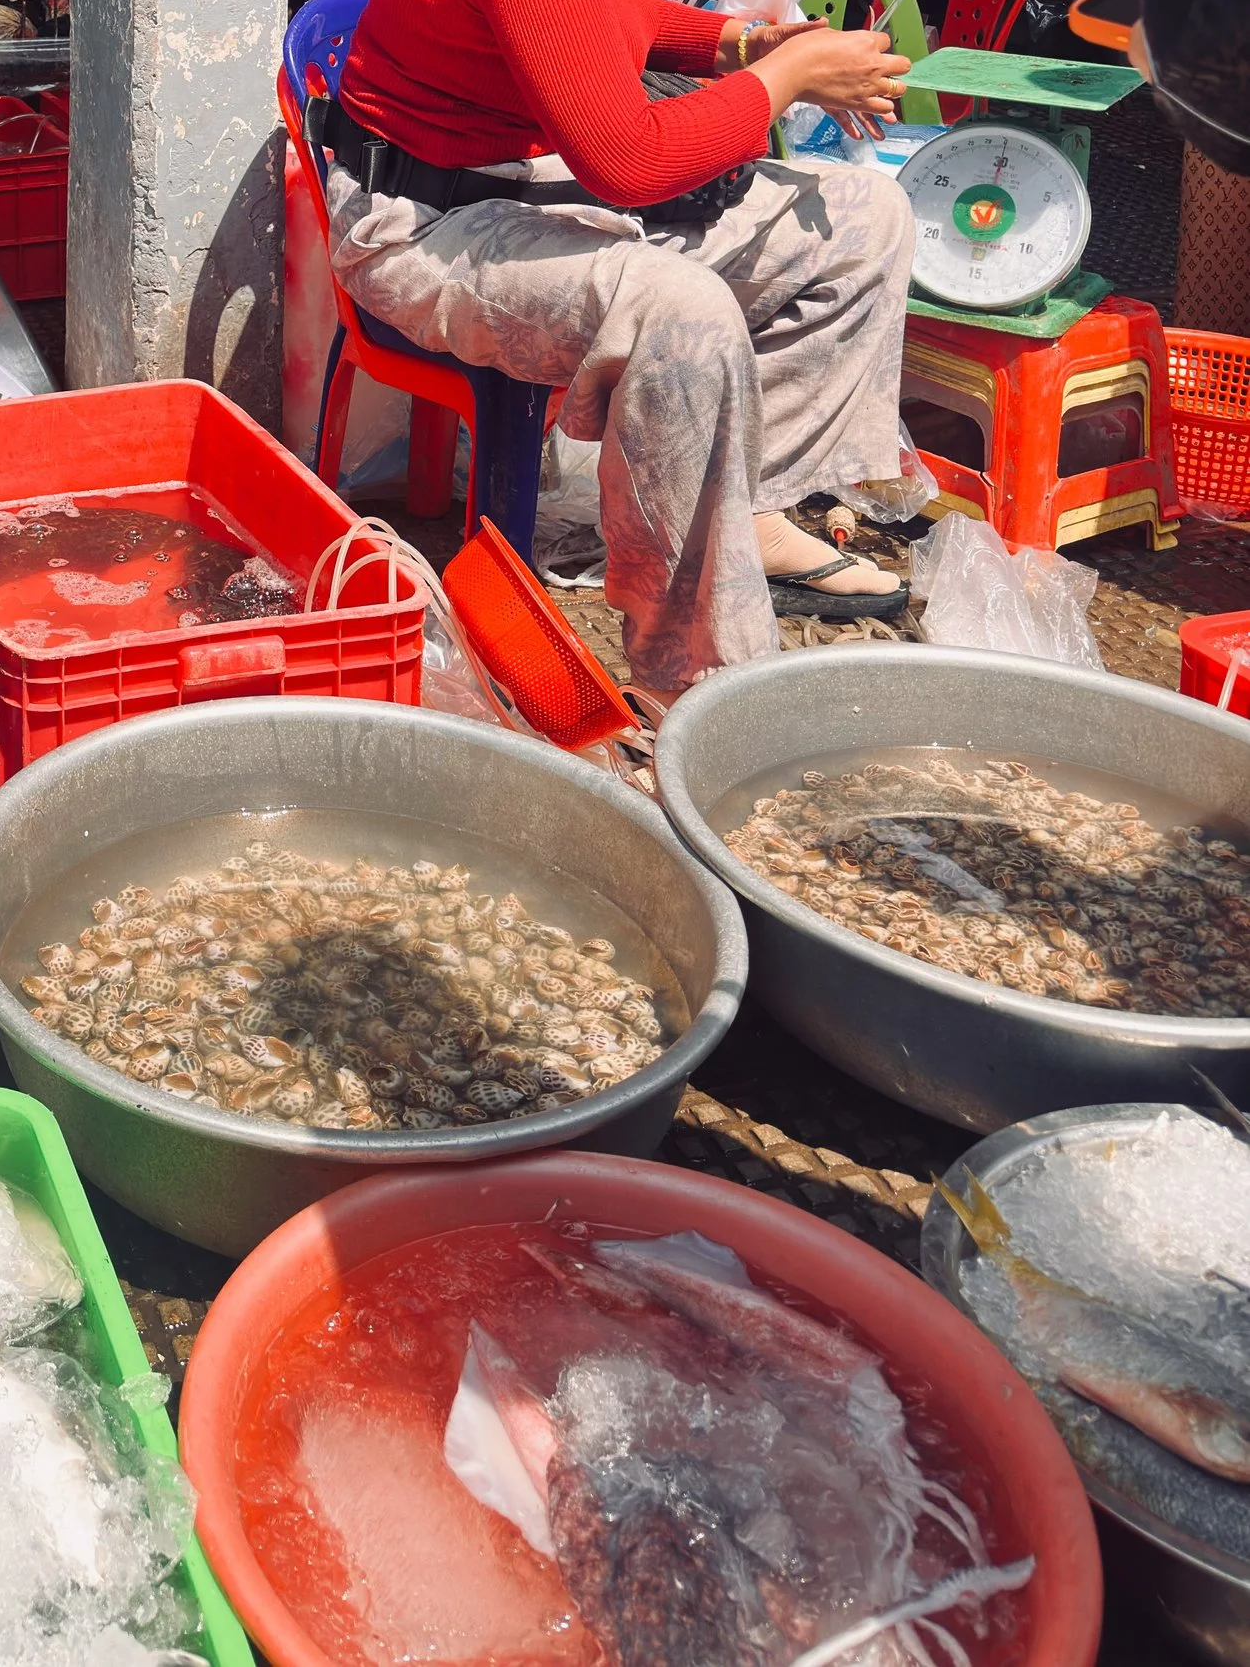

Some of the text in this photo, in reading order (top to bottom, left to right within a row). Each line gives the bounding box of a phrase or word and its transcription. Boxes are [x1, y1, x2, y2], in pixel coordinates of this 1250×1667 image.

[993, 156, 1009, 168] 30
[934, 174, 950, 188] 25
[1043, 191, 1052, 204] 5
[923, 226, 940, 240] 20
[1019, 242, 1034, 255] 10
[968, 266, 982, 280] 15
